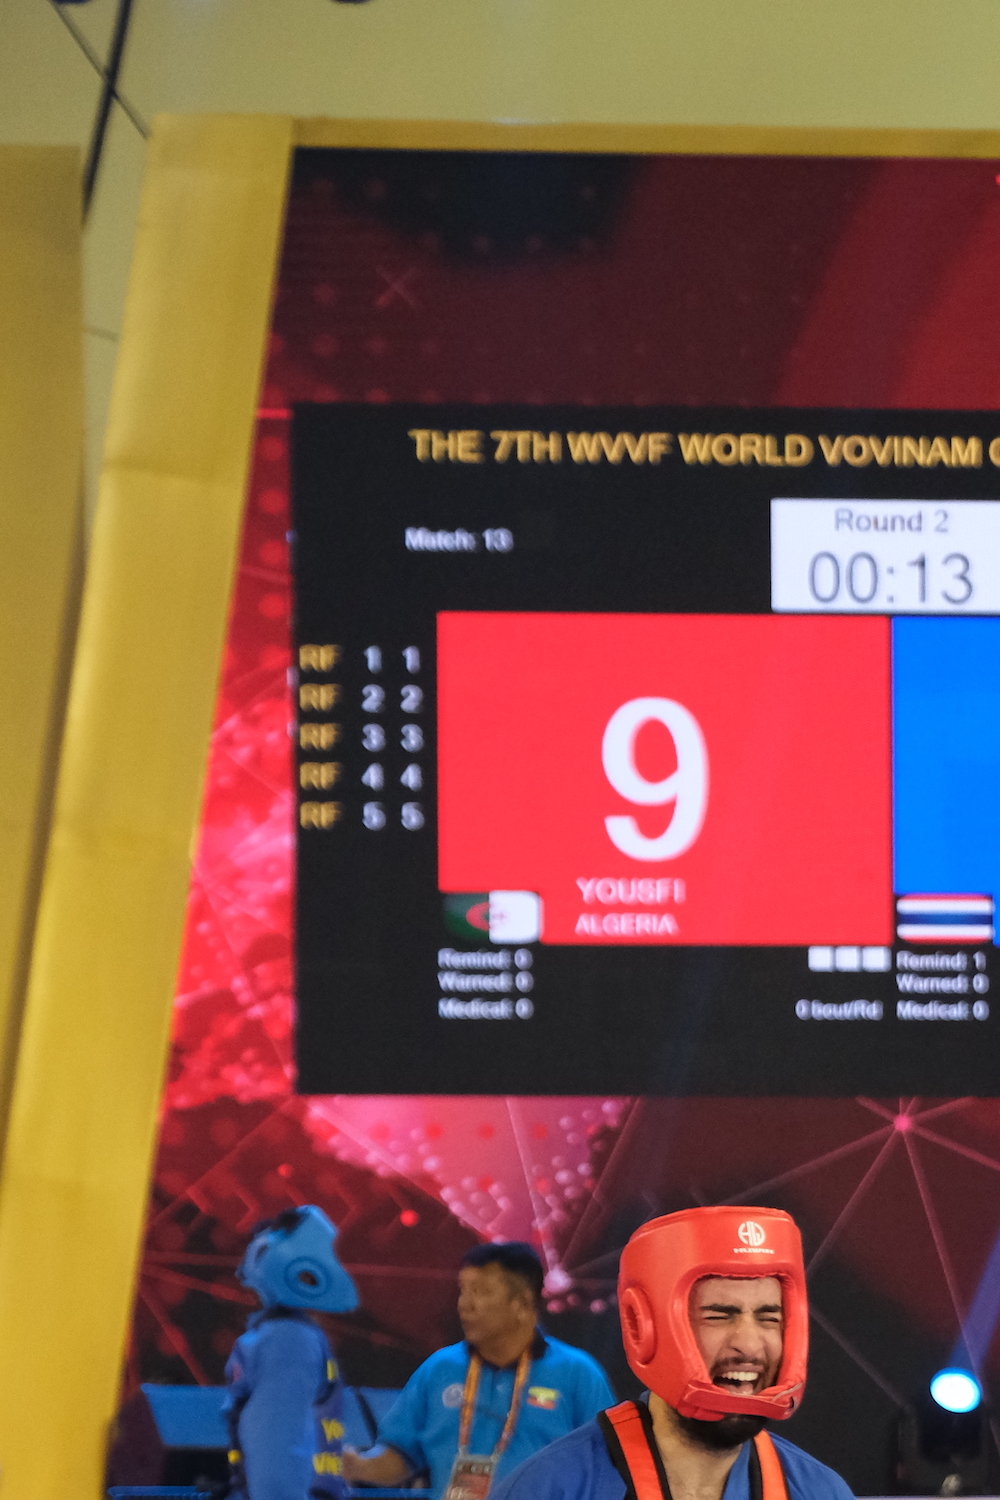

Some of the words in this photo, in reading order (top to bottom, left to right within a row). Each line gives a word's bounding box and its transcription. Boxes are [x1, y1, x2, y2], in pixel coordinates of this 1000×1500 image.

[409, 430, 482, 463] THE
[490, 431, 563, 463] 7TH
[567, 432, 670, 465] WVVF
[678, 433, 814, 467] WORLD
[818, 435, 983, 468] VOVINAM
[835, 508, 923, 533] Round
[934, 510, 949, 533] 2
[405, 527, 476, 551] Match:
[807, 550, 975, 605] 00:13
[298, 645, 341, 671] RF
[298, 684, 341, 711] RF
[298, 723, 341, 751] RF
[298, 762, 341, 790] RF
[601, 696, 709, 862] 9
[298, 801, 341, 830] RF
[575, 877, 686, 904] YOUSFI
[574, 913, 679, 937] ALGERIA
[896, 951, 969, 972] Remind:
[973, 952, 986, 971] 1
[896, 973, 970, 994] Warned:
[972, 973, 989, 994] 0
[896, 1000, 971, 1021] Medical:
[972, 1000, 990, 1021] 0
